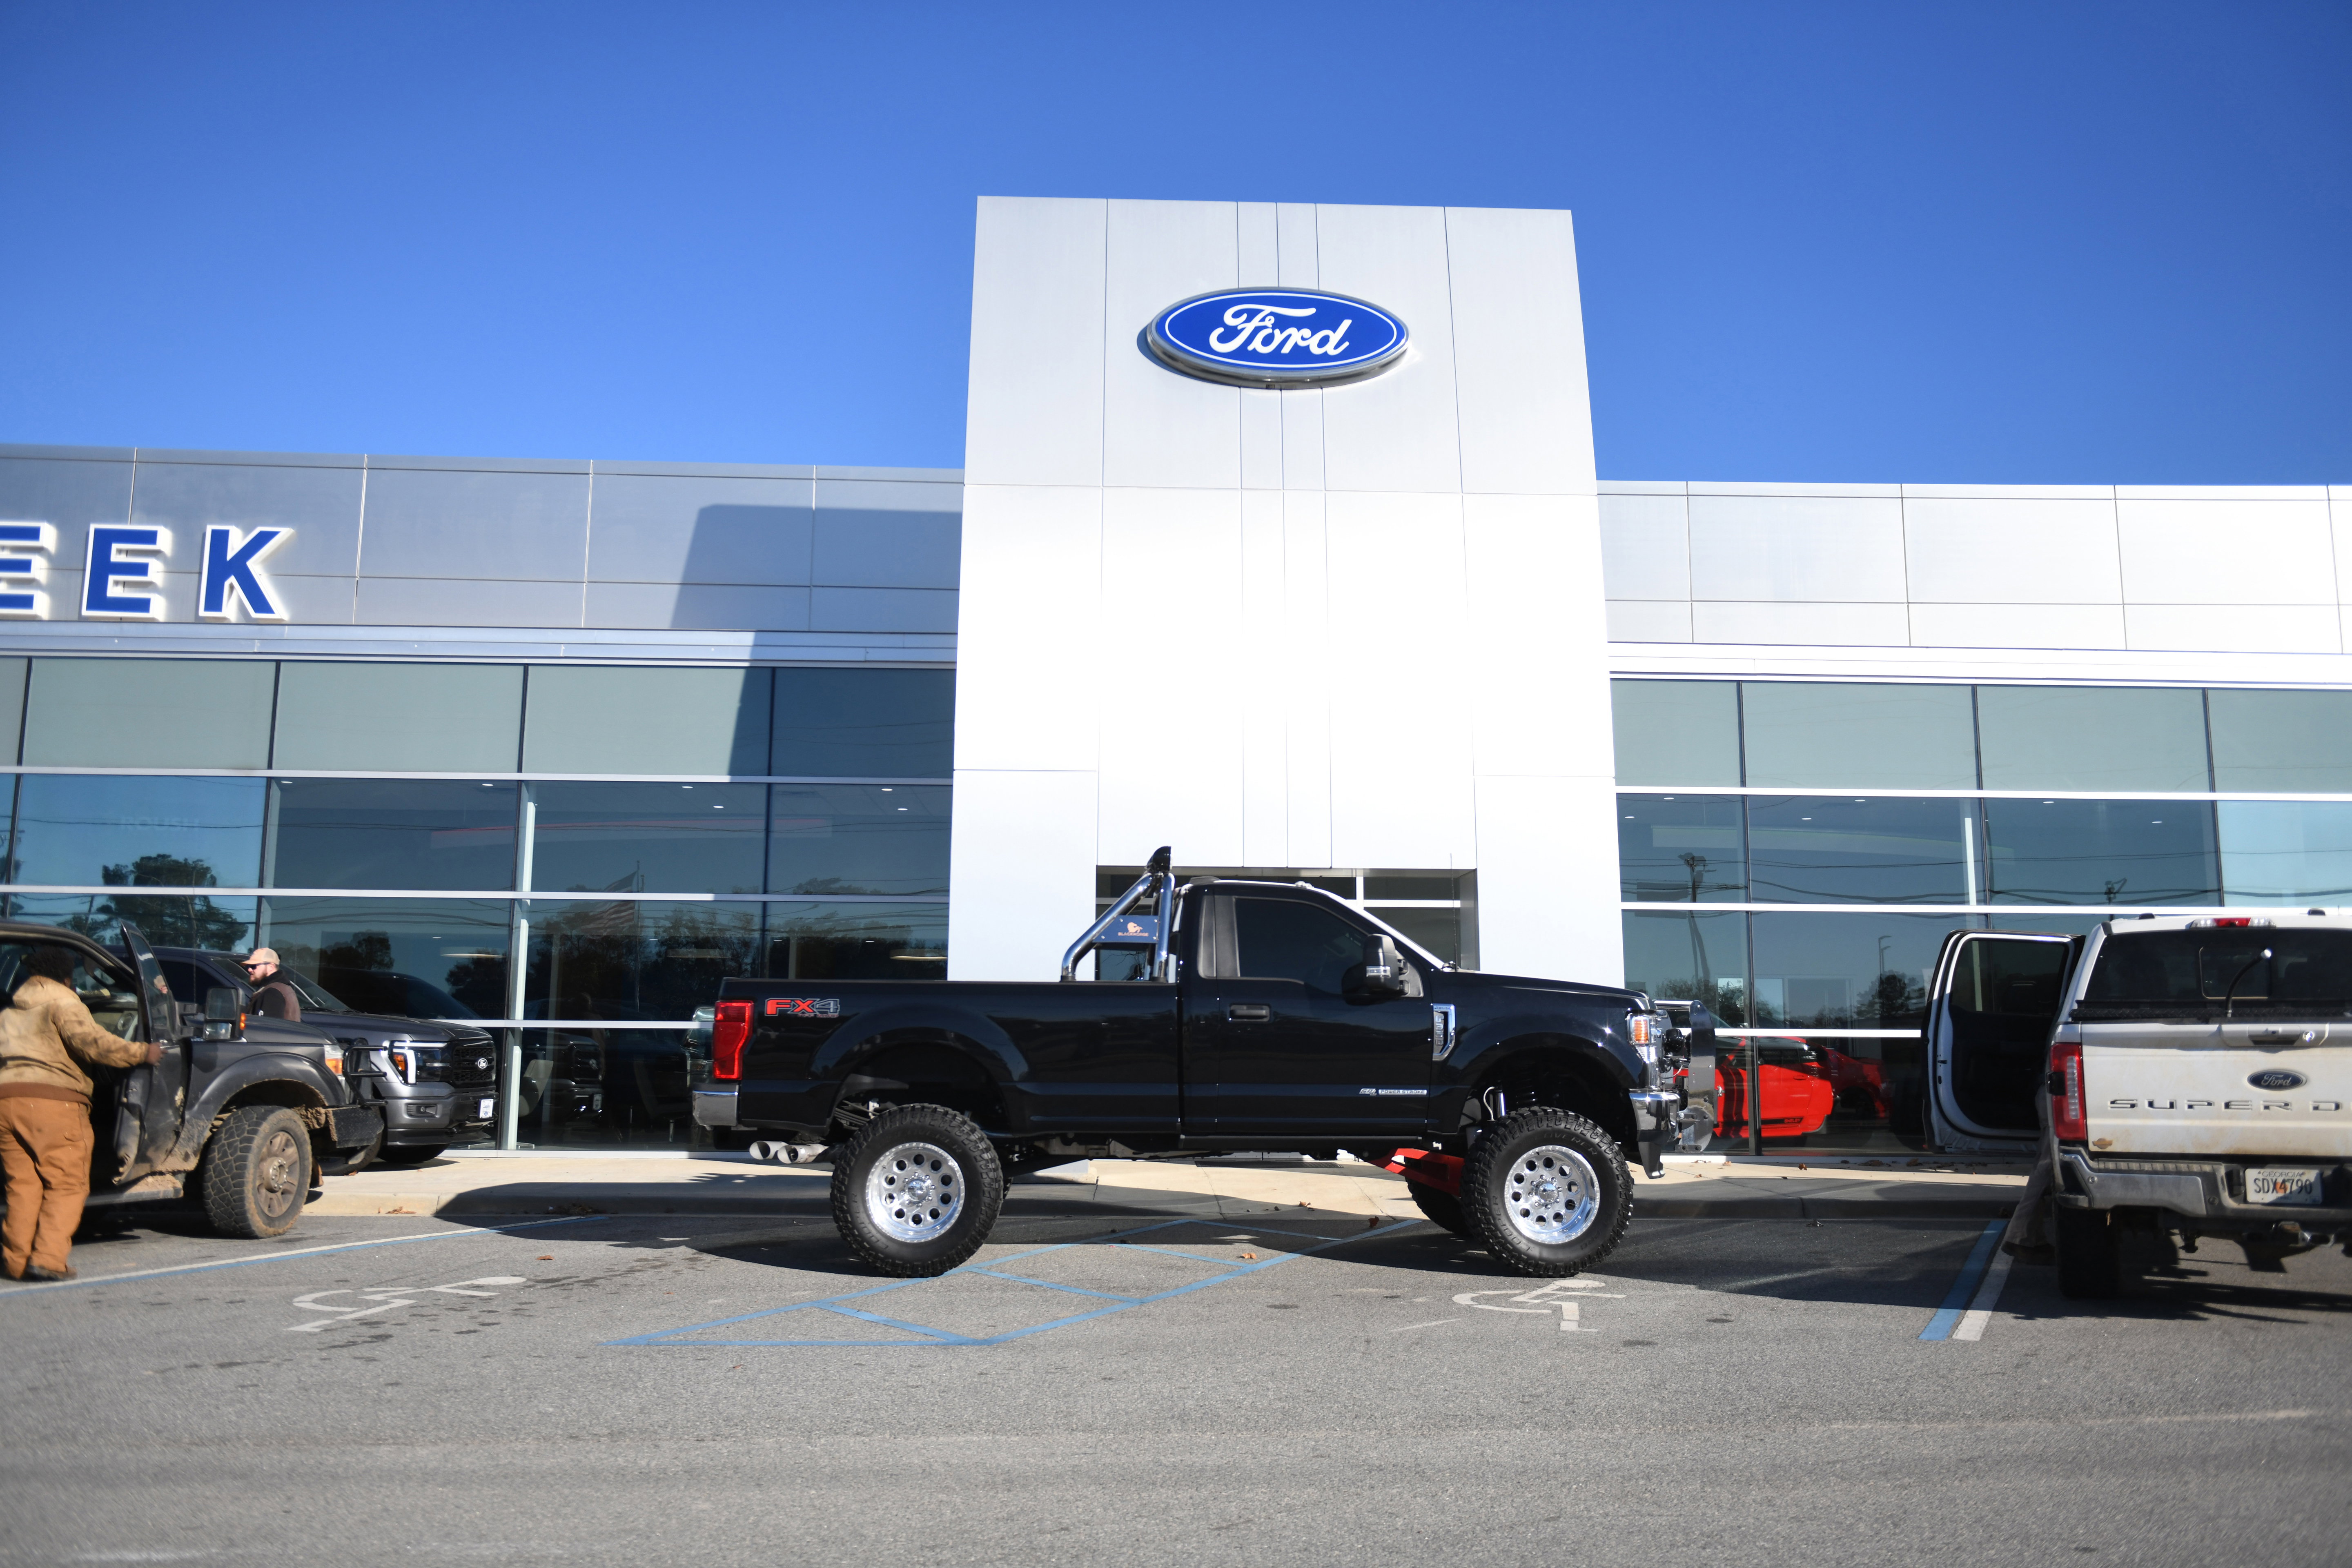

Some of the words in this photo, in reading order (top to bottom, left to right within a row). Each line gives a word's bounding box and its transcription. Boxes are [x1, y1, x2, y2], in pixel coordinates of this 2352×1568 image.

[1209, 303, 1352, 356] Ford
[120, 817, 200, 831] ROUSH
[765, 998, 840, 1016] FX4
[2261, 1074, 2292, 1087] Ford
[2108, 1098, 2292, 1111] SUPER
[2310, 1101, 2352, 1112] D
[2254, 1178, 2312, 1195] SDX4790
